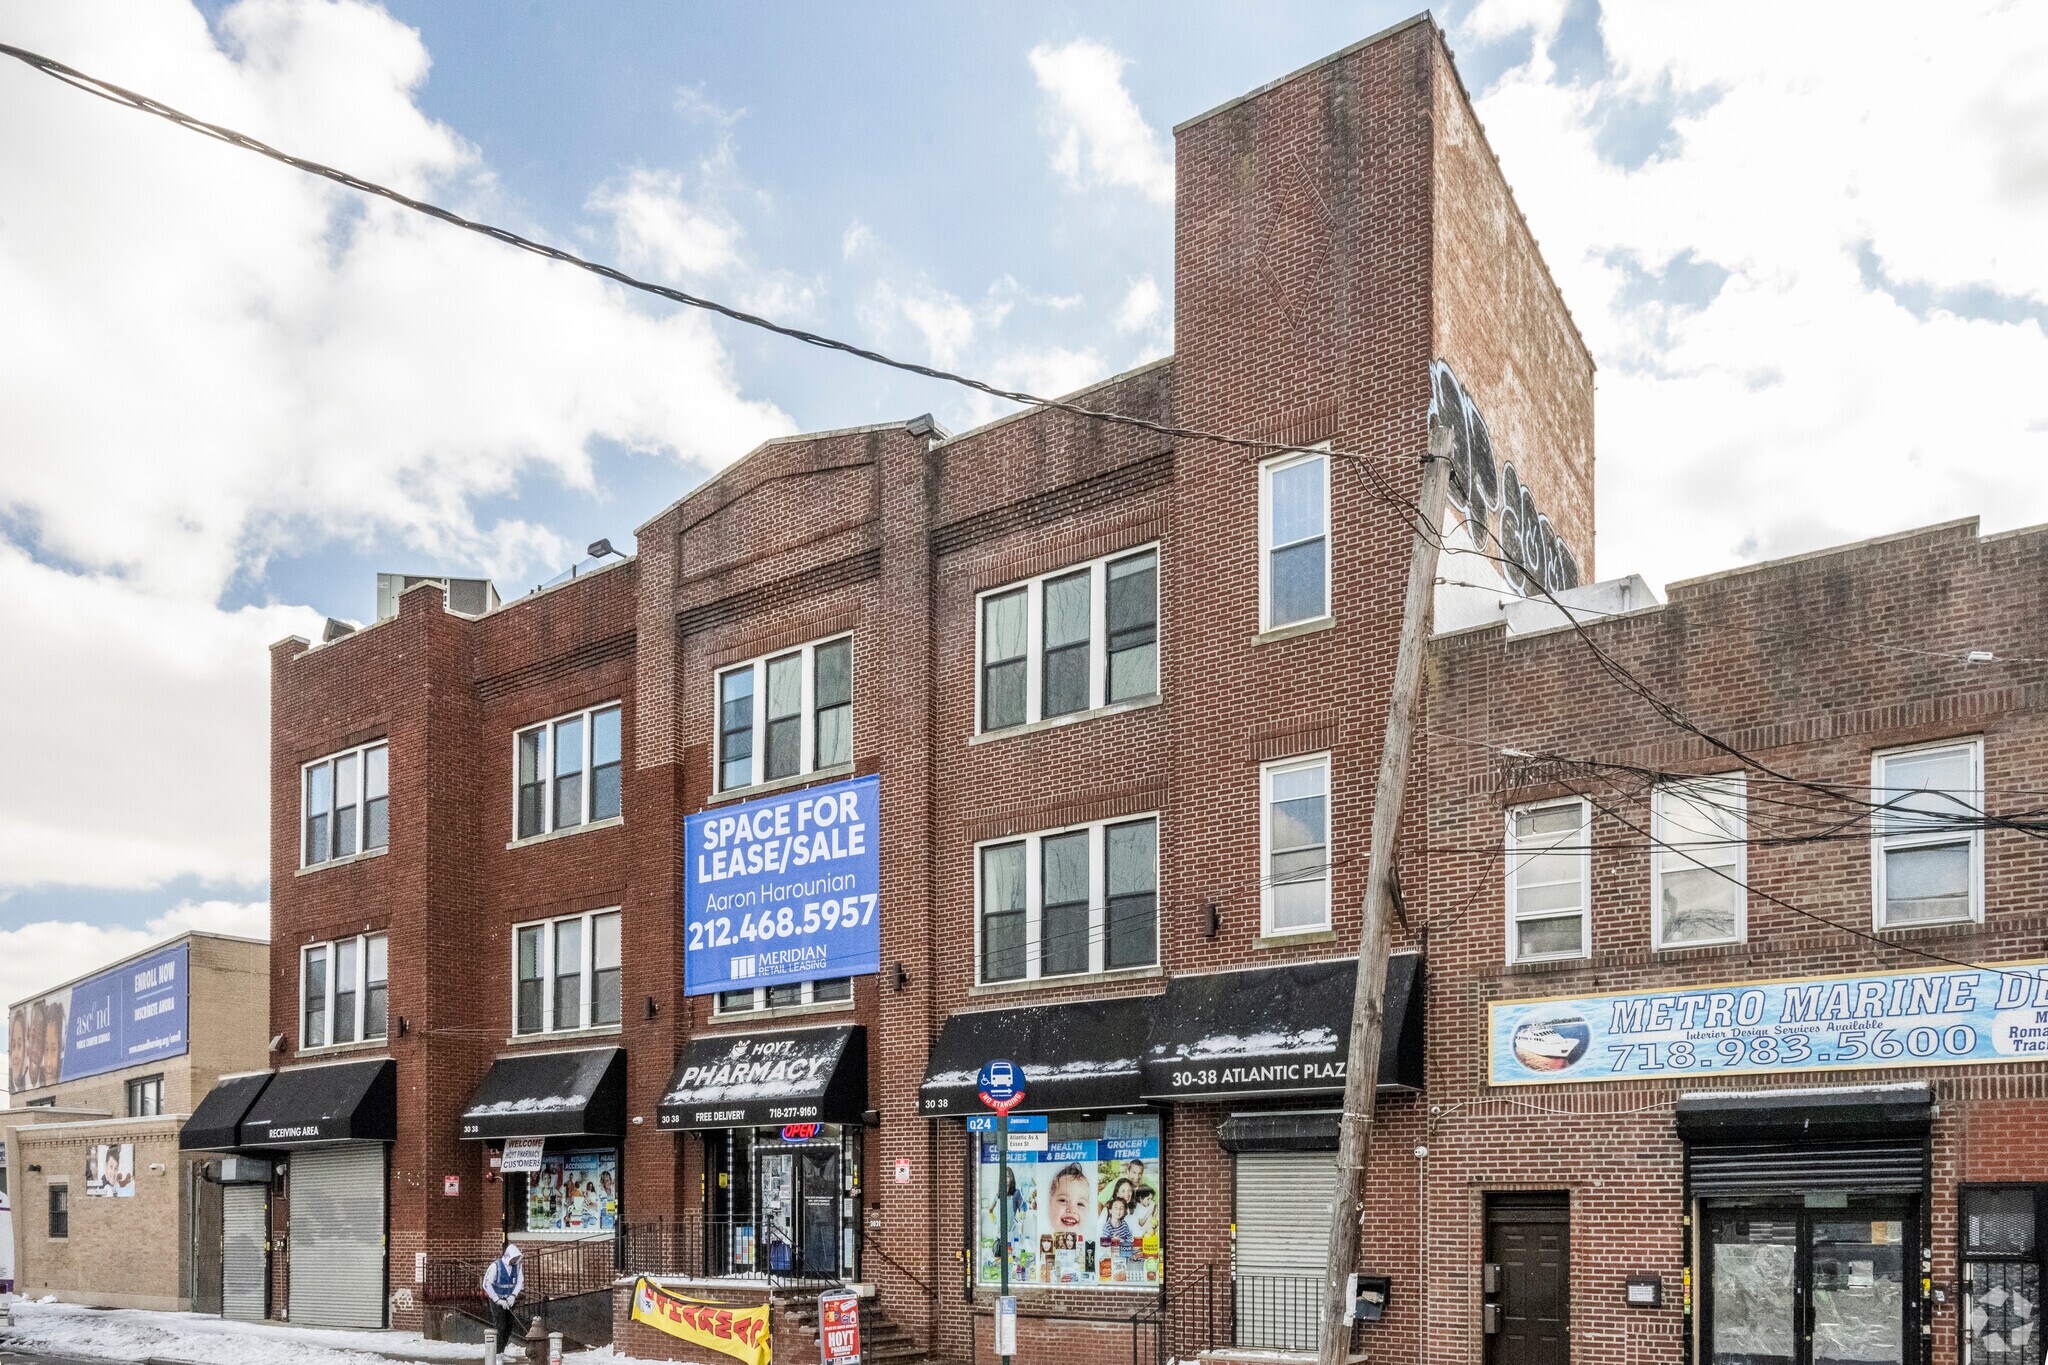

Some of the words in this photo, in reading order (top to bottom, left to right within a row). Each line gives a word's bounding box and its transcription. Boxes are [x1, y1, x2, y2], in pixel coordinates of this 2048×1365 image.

[704, 804, 790, 850] SPACE
[797, 791, 860, 832] FOR
[698, 823, 866, 884] LEASE/SALE
[706, 890, 756, 913] Aaron
[761, 872, 856, 904] Harounian
[688, 893, 878, 952] 212.468.5957
[759, 944, 827, 966] MERIDIAN
[759, 964, 787, 977] RETAIL
[789, 958, 827, 973] LEASING
[134, 967, 157, 993] ENROLL
[158, 960, 175, 985] NOW
[1608, 989, 1767, 1035] METRO
[1779, 973, 1981, 1024] MARINE
[76, 995, 110, 1036] ascend
[1686, 1030, 1726, 1040] Interior
[1731, 1027, 1768, 1038] Design
[1774, 1023, 1820, 1035] Services
[1826, 1019, 1883, 1032] Available
[751, 1040, 795, 1056] HOYT
[1608, 1024, 1977, 1073] 718.983.5600
[2013, 1039, 2048, 1052] Trac
[679, 1057, 827, 1088] PHARMACY
[1172, 1069, 1217, 1087] 30-38
[1221, 1064, 1299, 1084] ATLANTIC
[1303, 1062, 1348, 1079] PLAZ
[925, 1100, 936, 1108] 30
[937, 1099, 948, 1108] 38
[982, 1094, 992, 1104] NO
[992, 1093, 1021, 1108] STANDING
[662, 1115, 670, 1124] 30
[671, 1114, 680, 1123] 38
[695, 1112, 713, 1122] FREE
[713, 1110, 745, 1121] DELIVERY
[769, 1106, 817, 1118] 718-277-9160
[471, 1125, 478, 1133] 38
[785, 1123, 815, 1137] OPEN
[970, 1118, 991, 1130] Q24
[269, 1127, 301, 1138] RECEIVING
[302, 1126, 319, 1136] AREA
[508, 1139, 543, 1148] WELCOME
[1050, 1142, 1083, 1151] HEALTH
[1107, 1139, 1148, 1149] GROCERY
[517, 1150, 540, 1159] PHARMACY
[990, 1153, 1027, 1162] SUPLIES
[1047, 1152, 1053, 1160] &
[1054, 1151, 1087, 1160] BEAUTY
[1114, 1148, 1141, 1158] ITEMS
[503, 1159, 540, 1169] CUSTOMERS
[827, 1330, 855, 1348] HOYT
